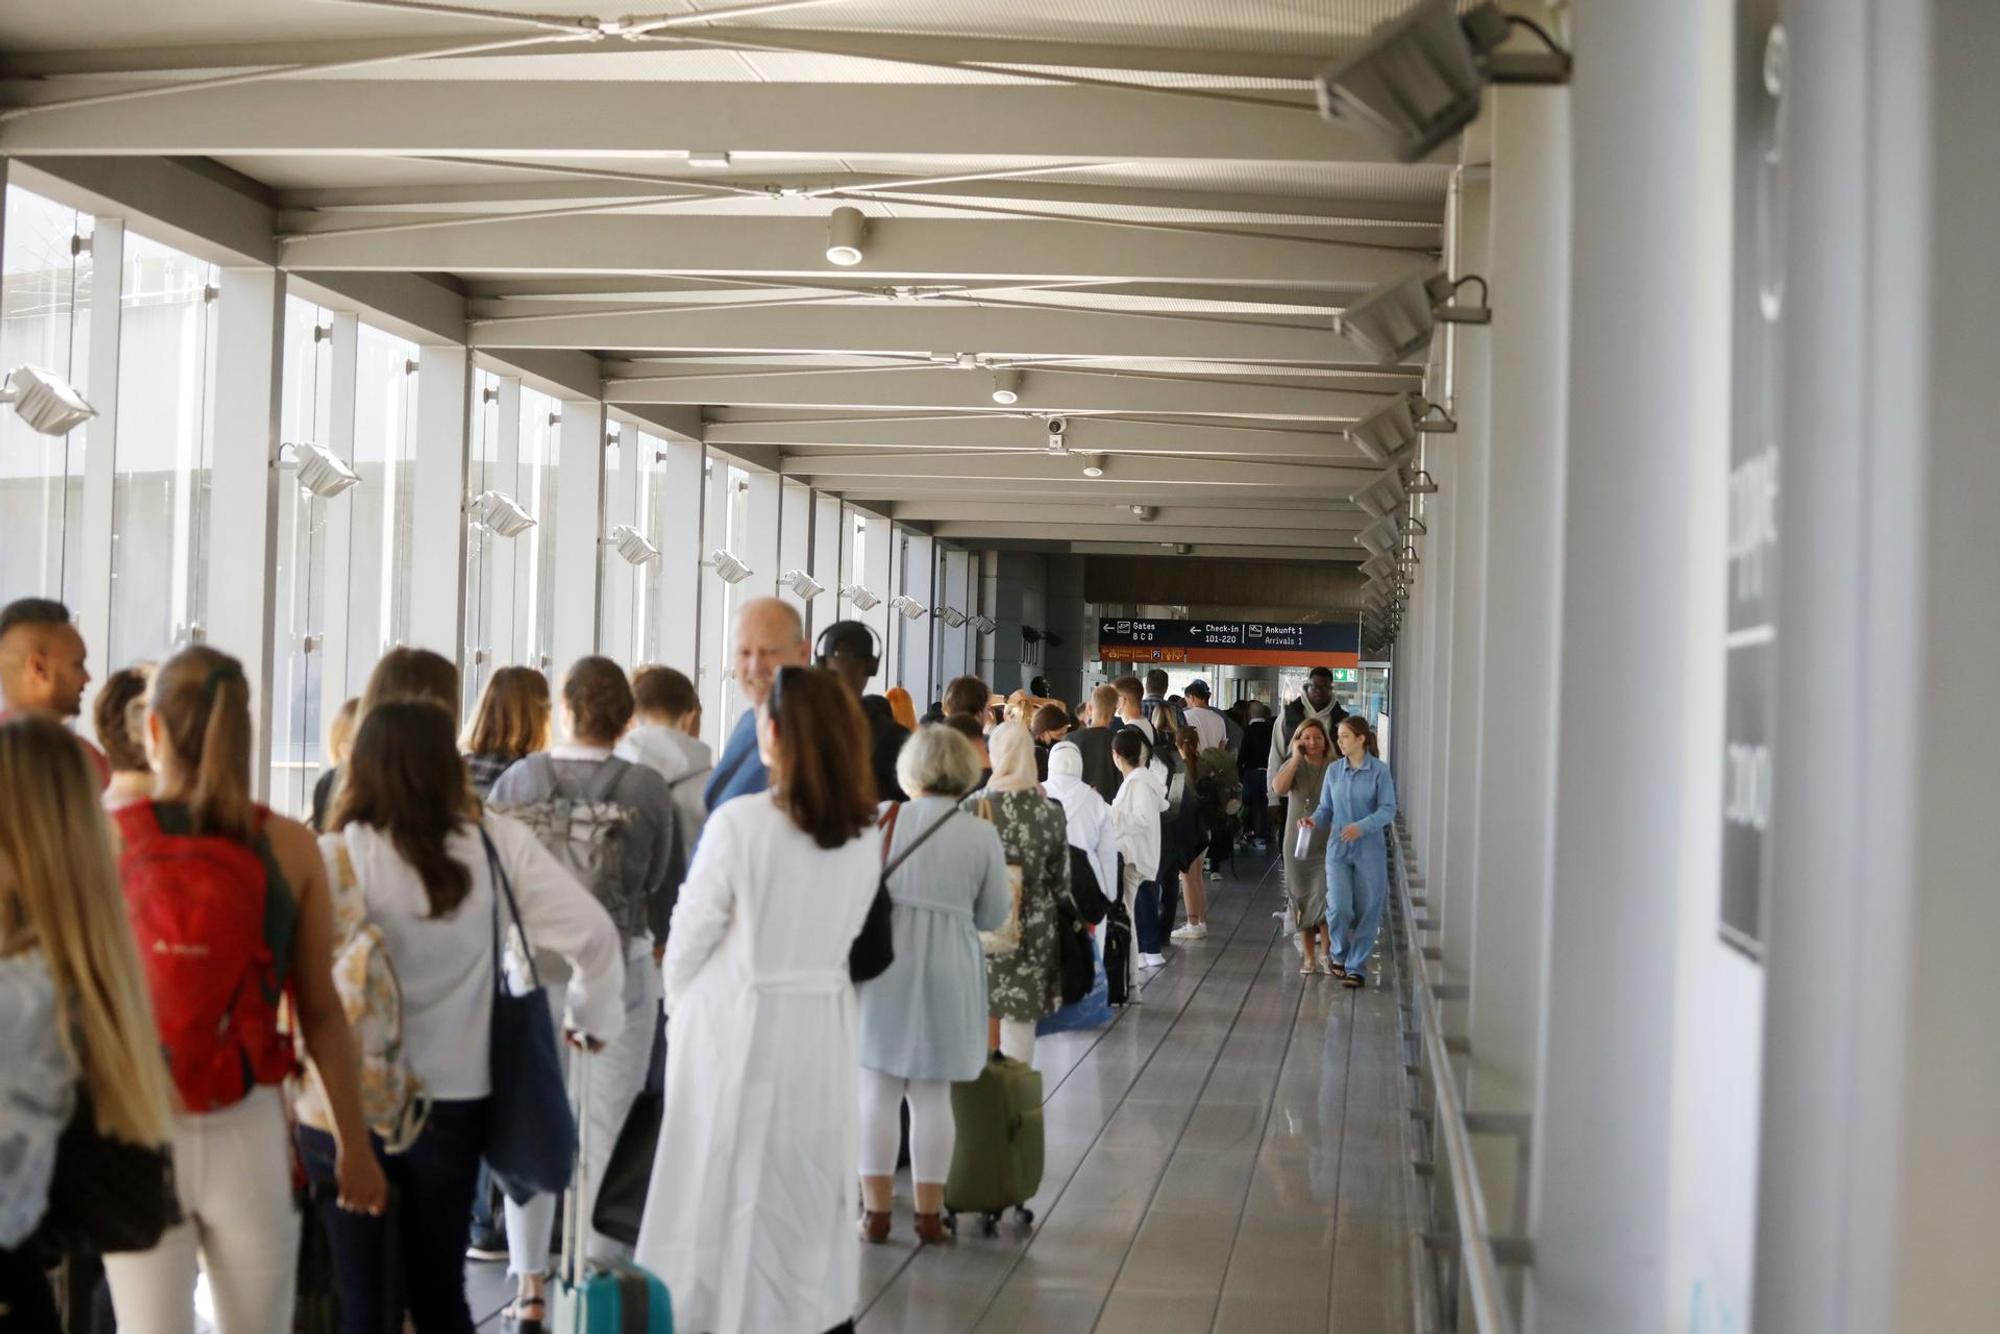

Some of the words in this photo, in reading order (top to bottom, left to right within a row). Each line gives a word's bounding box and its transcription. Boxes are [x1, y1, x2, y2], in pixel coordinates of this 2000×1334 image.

[1133, 622, 1155, 630] Gates
[1205, 624, 1239, 633] Check-in
[1265, 626, 1296, 635] Ankunft
[1205, 635, 1237, 643] 101-220
[1265, 636, 1295, 645] Arrivals
